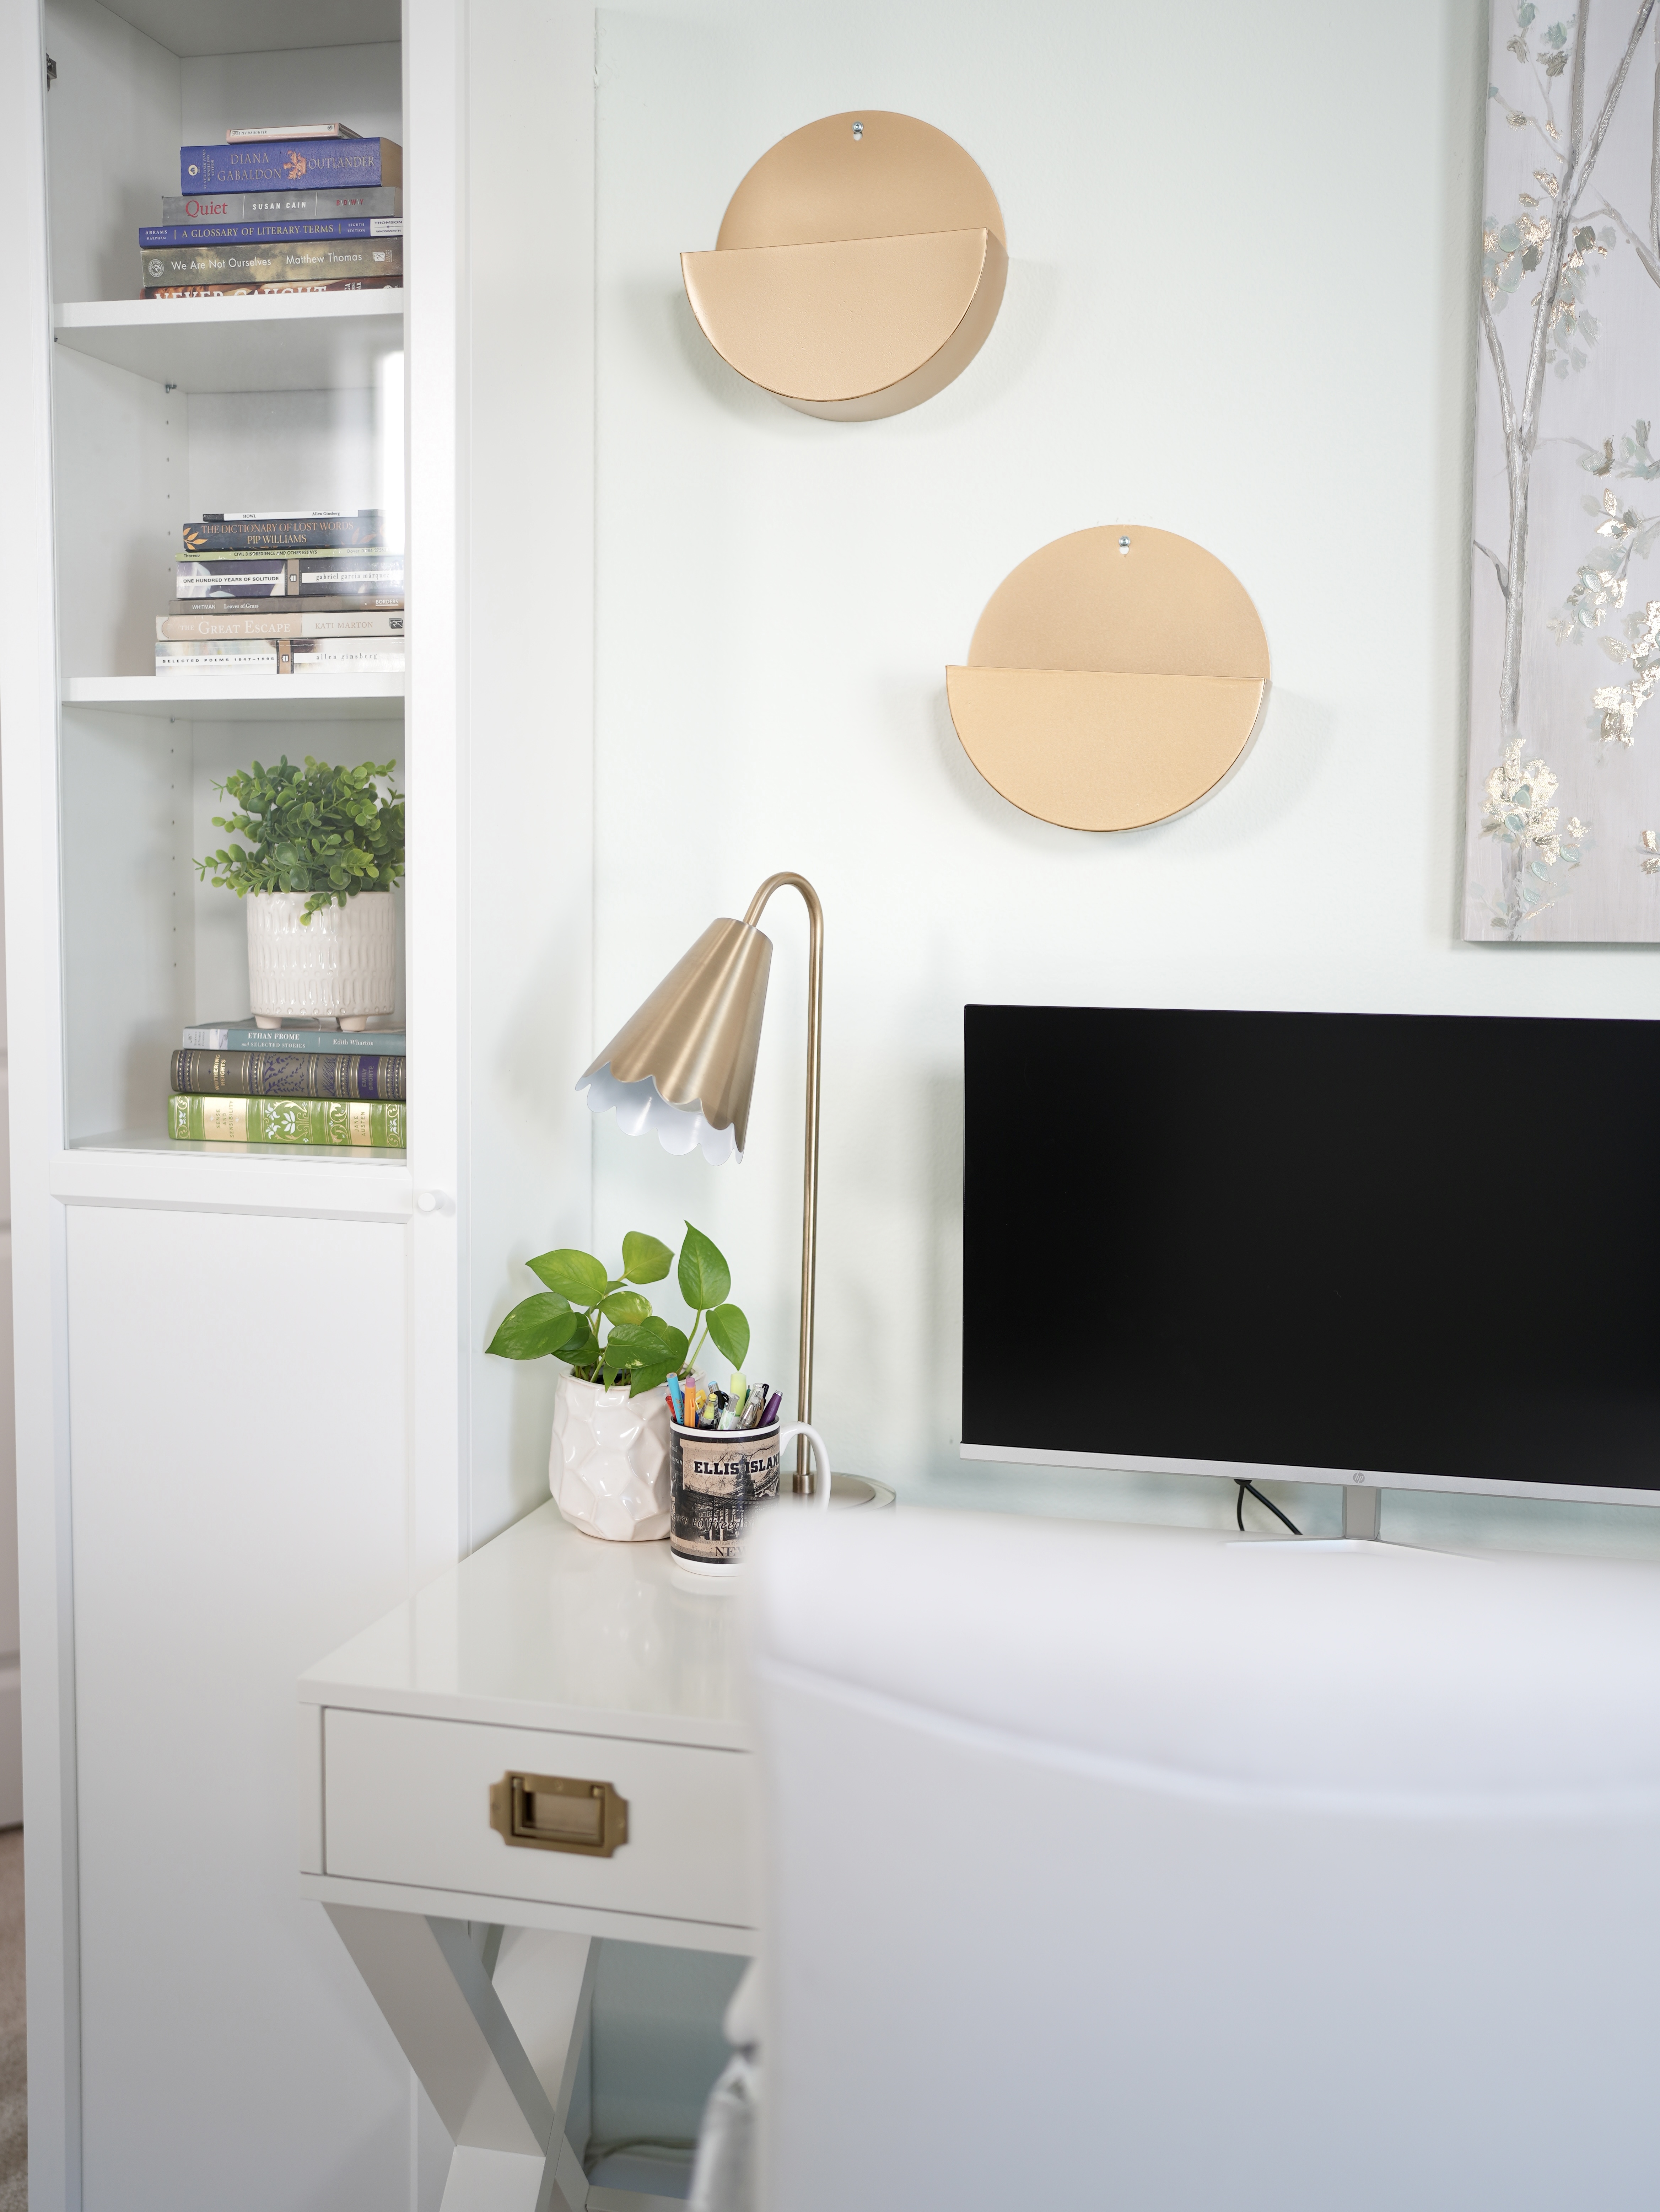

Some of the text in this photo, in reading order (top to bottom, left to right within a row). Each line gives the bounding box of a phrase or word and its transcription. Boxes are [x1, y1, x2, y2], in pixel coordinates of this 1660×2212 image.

[231, 153, 269, 165] DIANA
[309, 156, 374, 170] OUTLANDER
[218, 169, 282, 181] GABALDON
[185, 200, 228, 218] Quiet
[192, 228, 238, 237] GLOSSARY
[258, 226, 300, 235] LITERARY
[303, 225, 333, 233] TERMS
[171, 256, 271, 270] We Are Not Ourselves
[286, 252, 362, 265] Matthew Thomas
[201, 521, 354, 533] THE DICTIONARY OF LOST WORDS
[248, 535, 307, 544] PIP WILLIAMS
[316, 573, 339, 581] gabriel
[341, 573, 360, 581] garcía
[199, 621, 240, 634] GREAT
[245, 620, 291, 634] ESCAPE
[341, 653, 377, 661] ginsberg
[694, 1452, 780, 1475] ELLIS ISLAN
[1355, 1472, 1364, 1483] hp
[672, 1512, 689, 1525] oors
[693, 1518, 704, 1528] to
